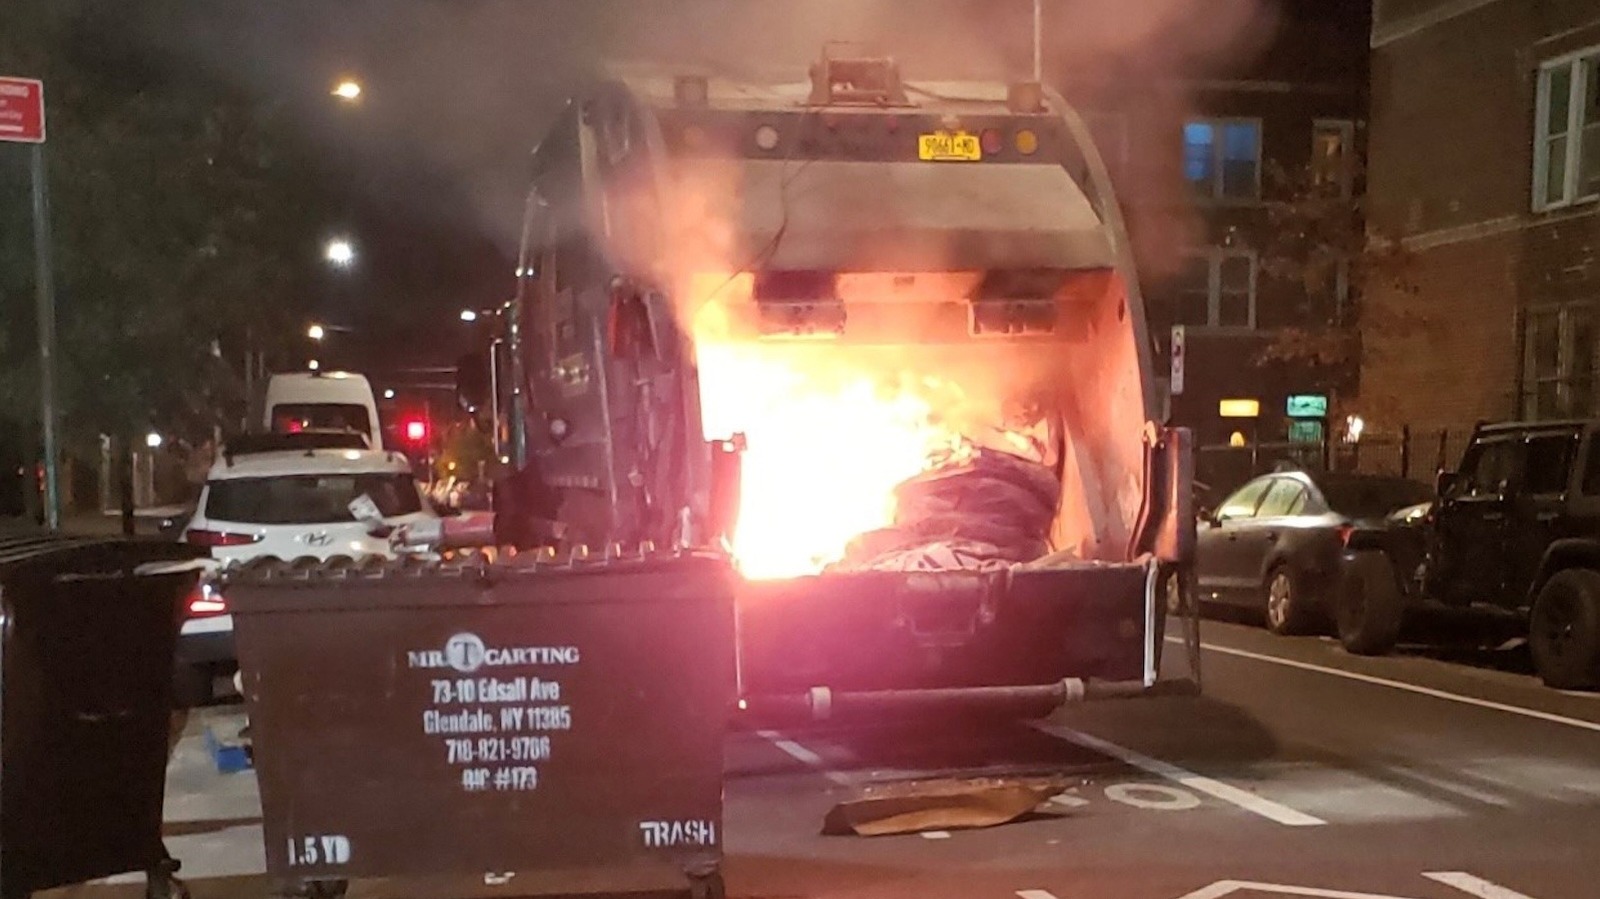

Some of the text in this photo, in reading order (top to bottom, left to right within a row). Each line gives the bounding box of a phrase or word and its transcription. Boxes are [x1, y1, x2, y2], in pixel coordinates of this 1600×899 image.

[484, 646, 580, 666] CARTING
[431, 676, 560, 703] 73-10 Edsall Ave
[423, 705, 572, 735] Glendale, NY 11385
[445, 735, 551, 765] 718-821-9706
[493, 766, 537, 791] #173
[639, 820, 715, 847] TRASH
[287, 835, 351, 866] 1.5 YD
